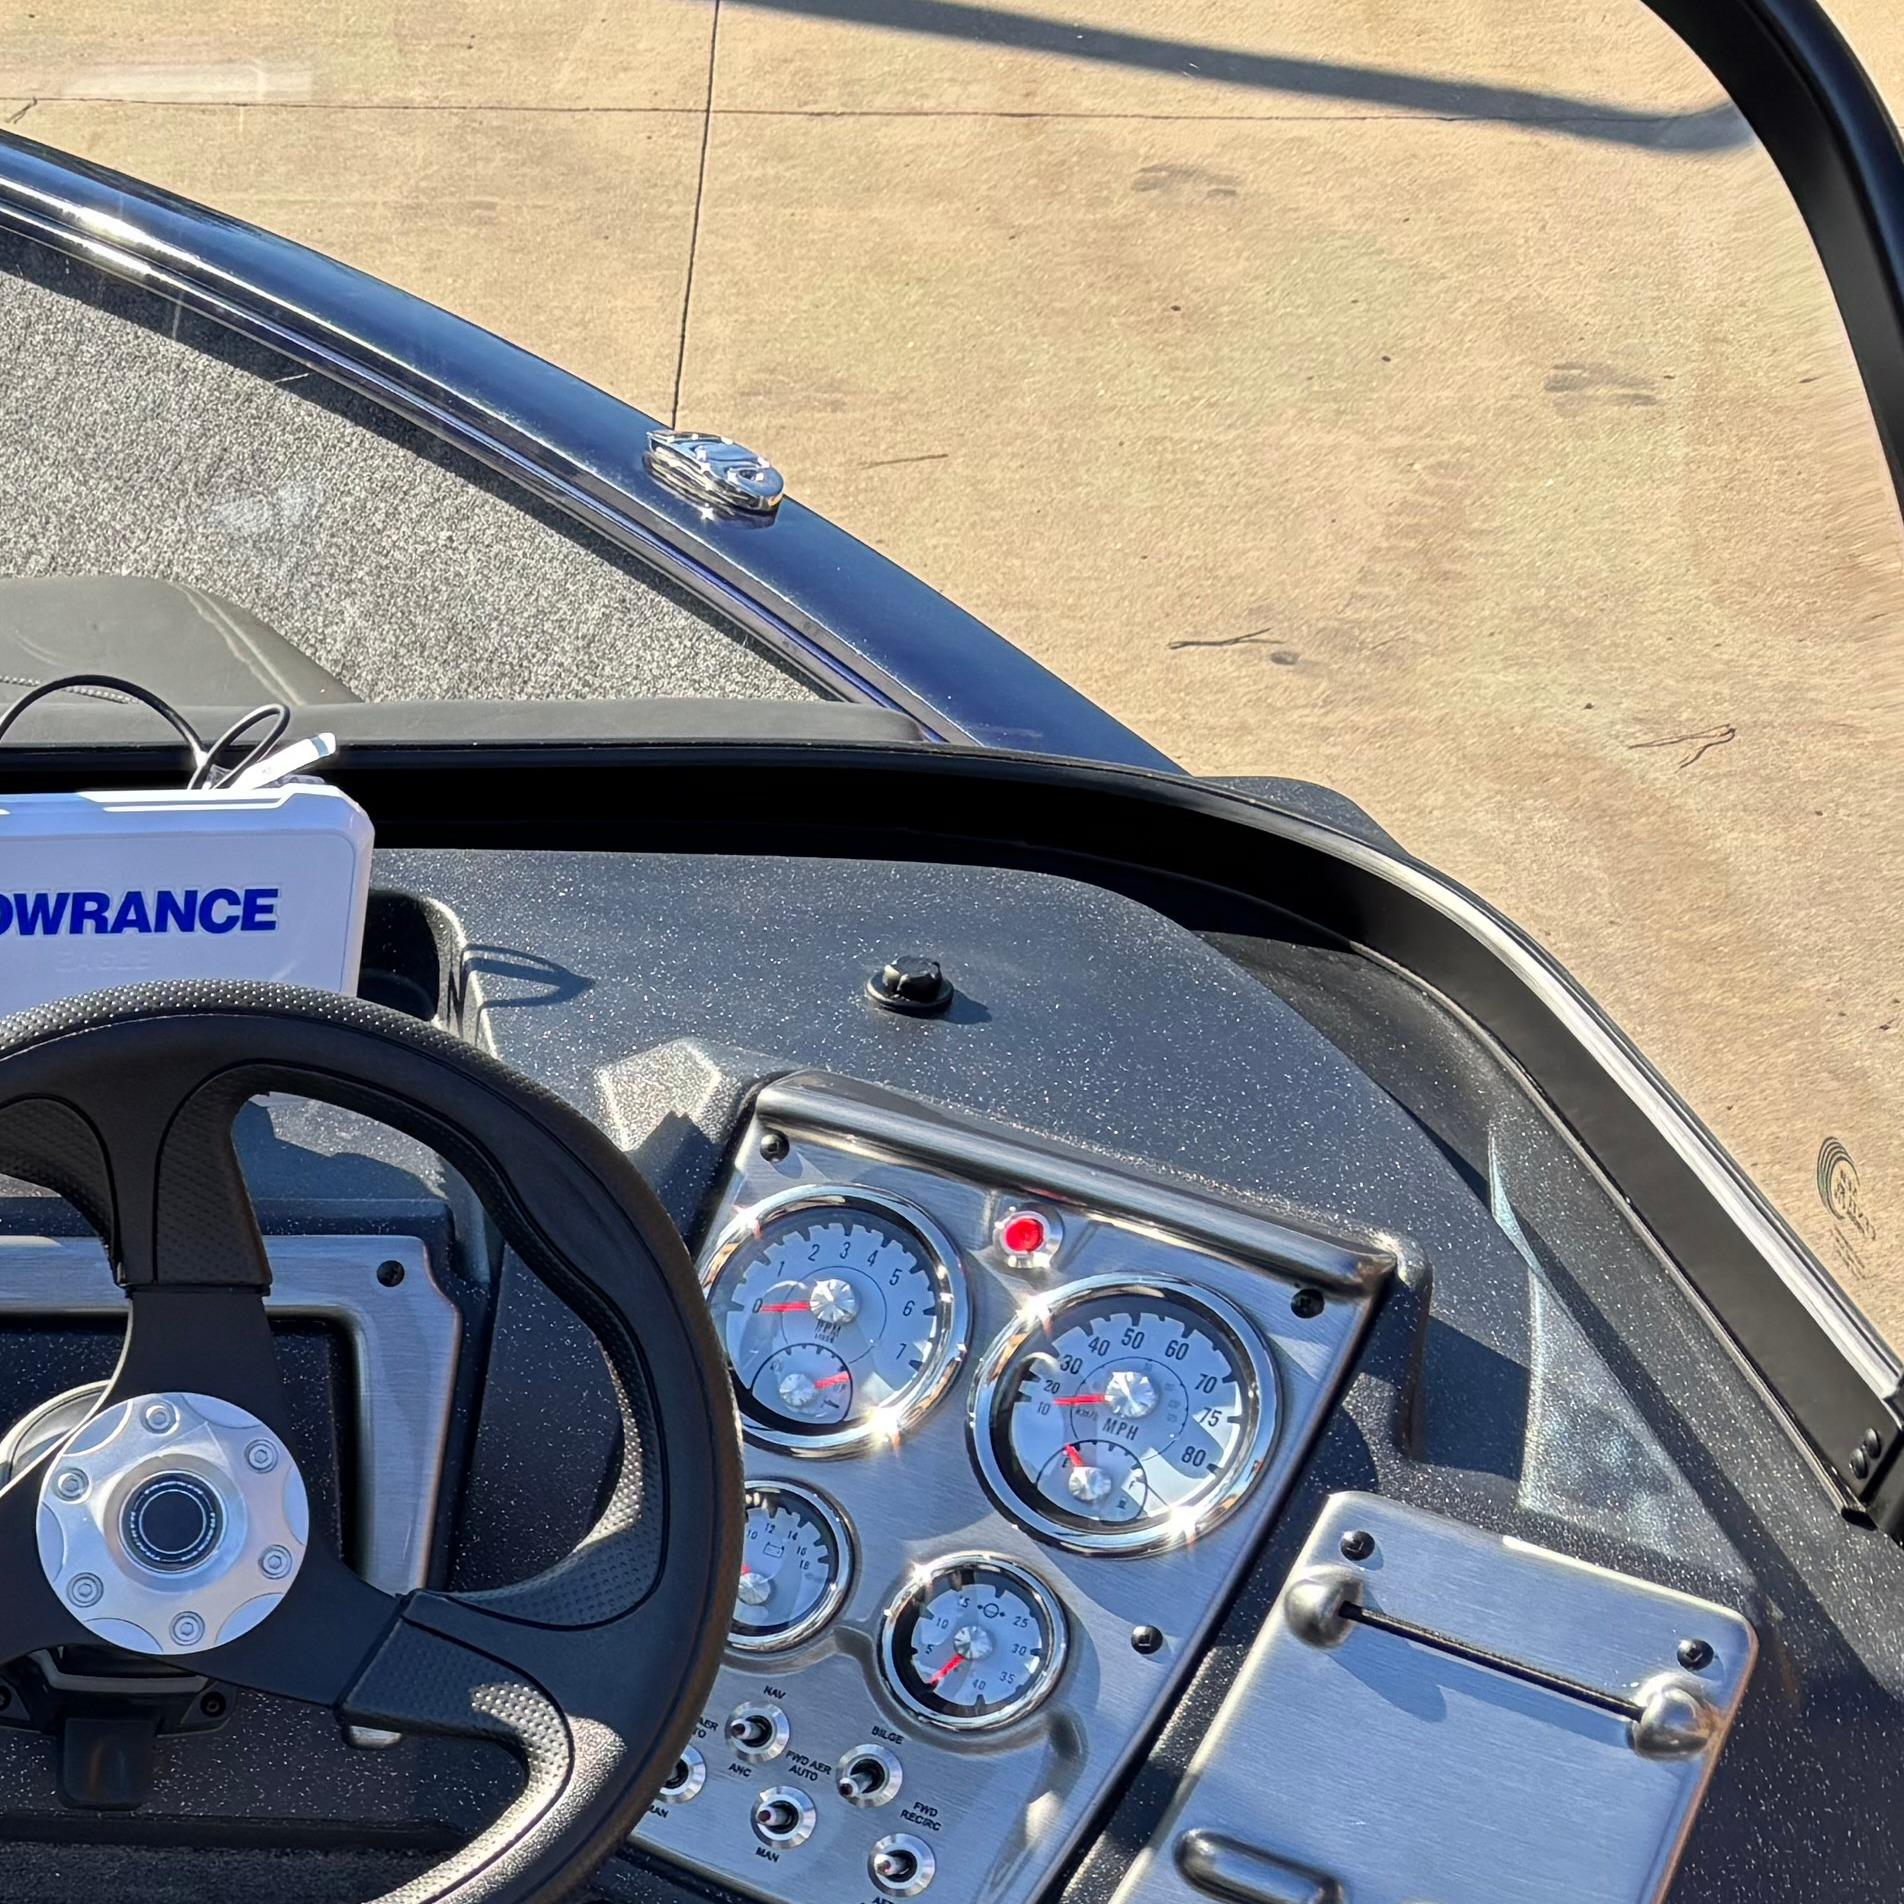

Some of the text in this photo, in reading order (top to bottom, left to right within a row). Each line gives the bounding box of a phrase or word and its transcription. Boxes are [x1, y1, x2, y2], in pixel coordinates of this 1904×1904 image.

[808, 1244, 820, 1262] 2
[840, 1242, 851, 1260] 3
[867, 1250, 879, 1267] 4
[777, 1261, 785, 1277] 1
[889, 1268, 902, 1286] 5
[752, 1298, 763, 1314] 0
[902, 1300, 915, 1317] 6
[1088, 1336, 1110, 1357] 40
[1121, 1328, 1145, 1350] 50
[895, 1343, 907, 1360] 7
[1165, 1340, 1189, 1360] 60
[1060, 1354, 1083, 1375] 30
[1044, 1379, 1060, 1394] 20
[1194, 1373, 1218, 1394] 70
[1036, 1401, 1051, 1416] 10
[1200, 1407, 1222, 1427] 75
[1102, 1418, 1139, 1441] MPH
[1181, 1446, 1206, 1467] 80
[747, 1530, 758, 1539] 10
[765, 1523, 776, 1534] 12
[788, 1531, 798, 1540] 14
[797, 1546, 807, 1556] 16
[936, 1617, 949, 1629] 10
[1013, 1616, 1029, 1628] 25
[926, 1644, 935, 1655] 5
[1011, 1643, 1027, 1656] 30
[999, 1671, 1016, 1684] 35
[763, 1685, 786, 1699] NAV
[871, 1725, 904, 1745] BILGE
[728, 1763, 751, 1777] ANC
[785, 1750, 832, 1775] FWD AER
[789, 1765, 818, 1781] AUTO
[913, 1801, 938, 1817] FWD
[901, 1809, 942, 1832] RECIRC
[755, 1846, 780, 1863] MAN
